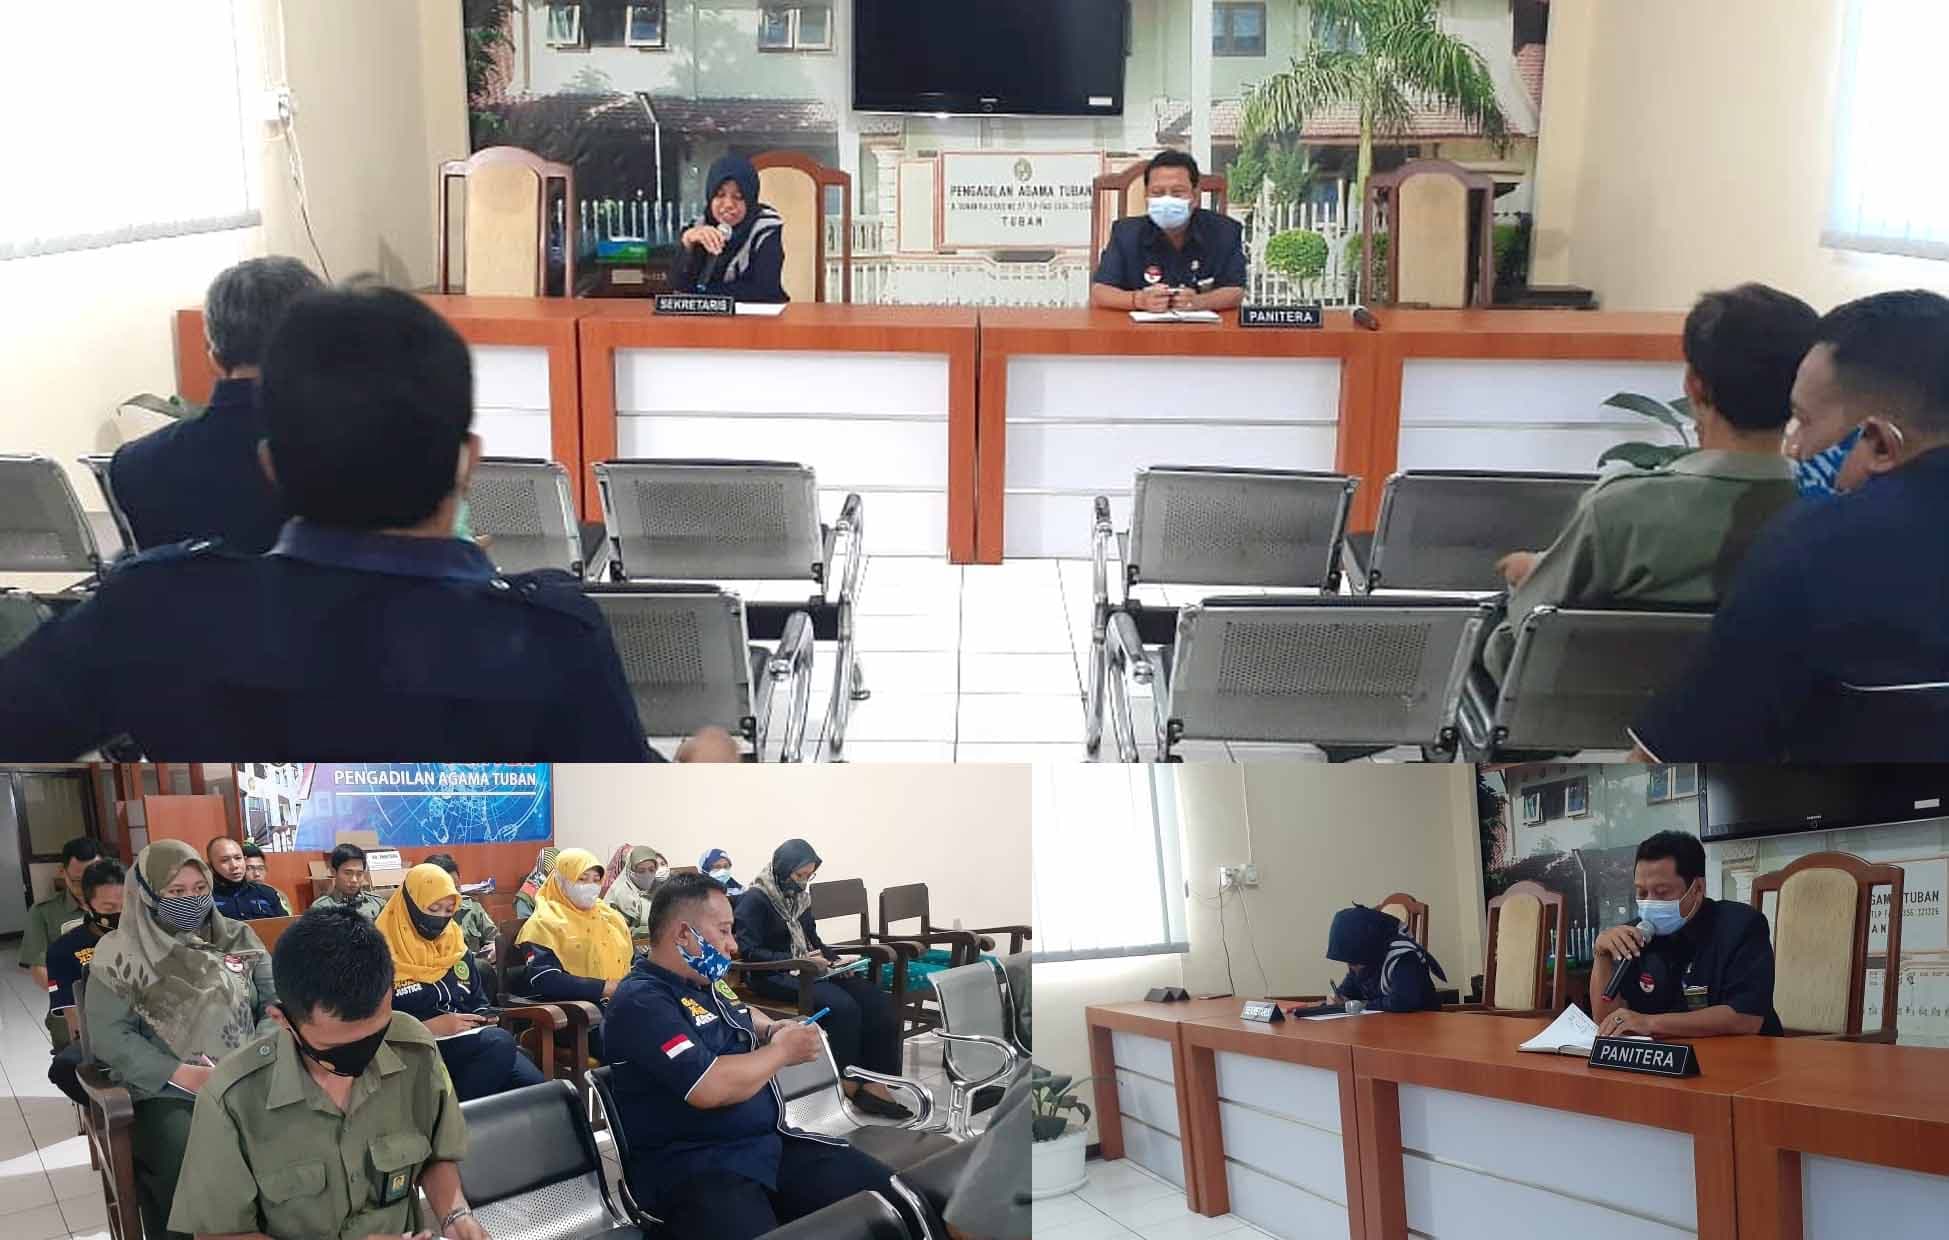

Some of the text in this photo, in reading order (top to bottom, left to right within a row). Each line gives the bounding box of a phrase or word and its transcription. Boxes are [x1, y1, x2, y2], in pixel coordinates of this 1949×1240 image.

[660, 298, 727, 311] SEKRETARIS
[1249, 310, 1313, 323] PANITERA
[334, 770, 537, 786] PENGADILAN AGAMA TUBAN
[1903, 890, 1939, 904] TUBAN
[395, 983, 423, 997] JUSTICE
[1600, 1045, 1674, 1067] PANITERA
